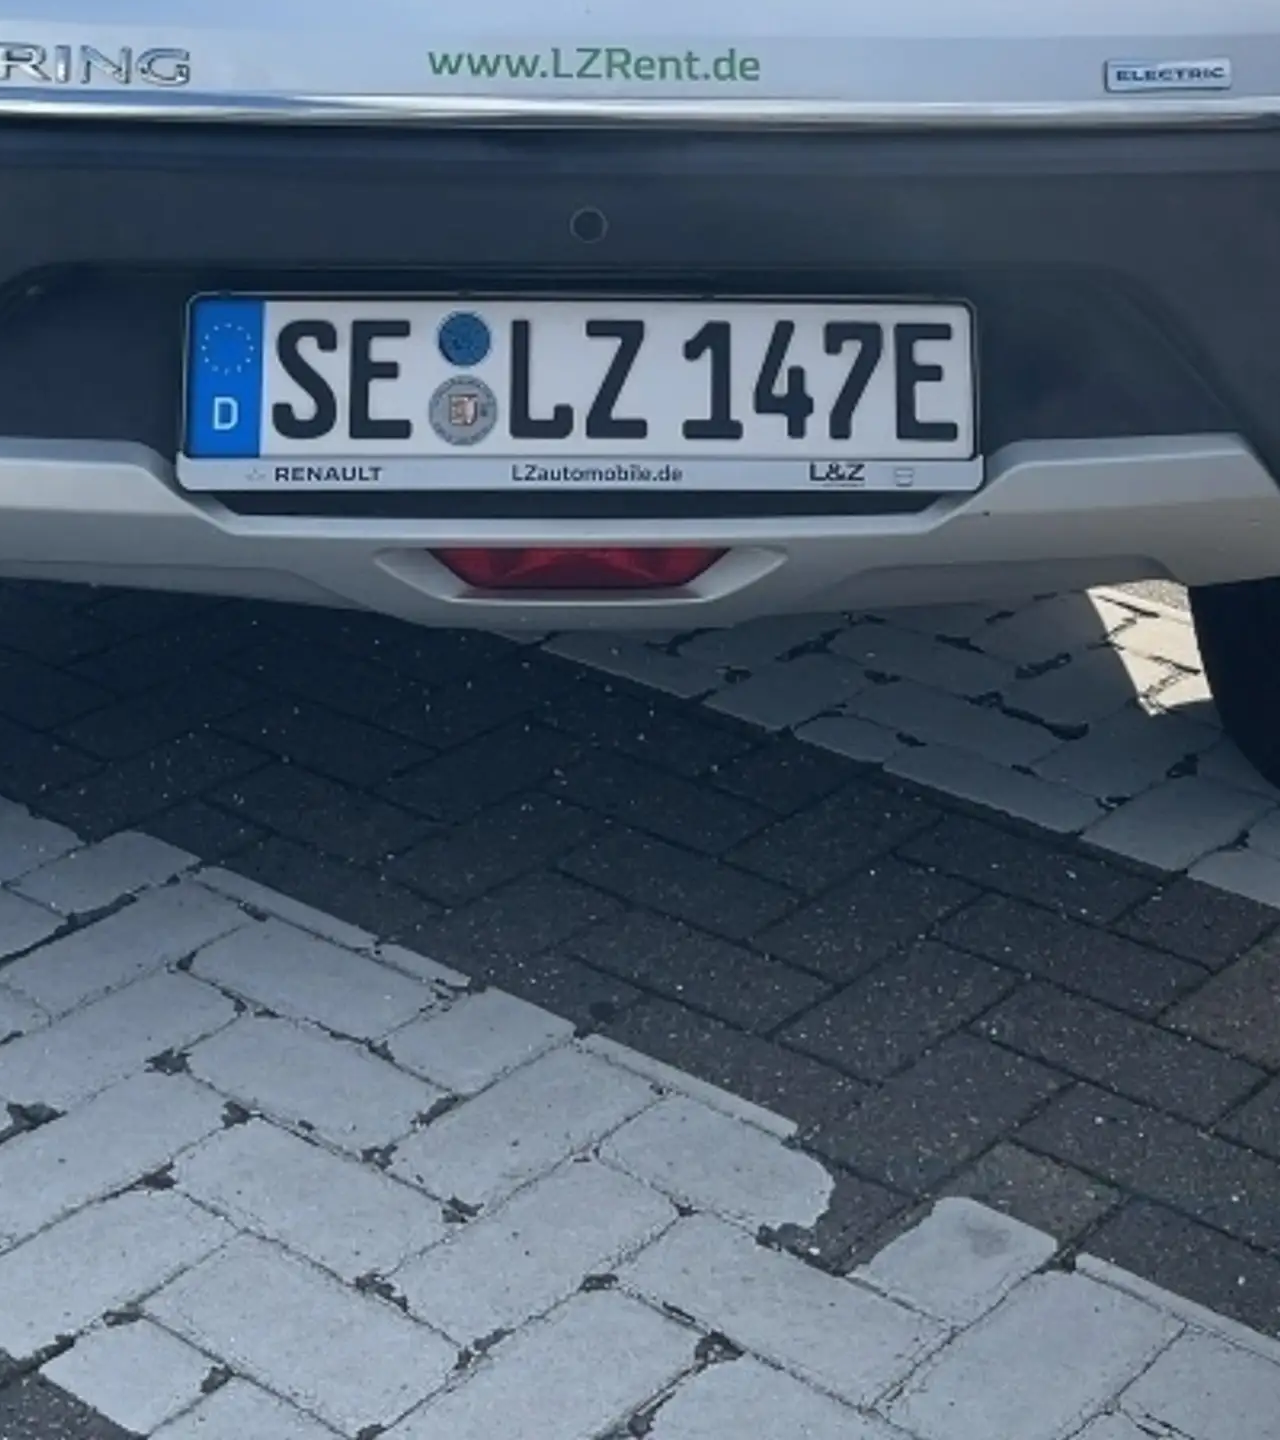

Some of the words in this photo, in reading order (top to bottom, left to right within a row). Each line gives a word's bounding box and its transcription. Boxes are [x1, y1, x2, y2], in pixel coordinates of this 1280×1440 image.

[428, 47, 761, 81] www.LZRent.de
[1116, 67, 1225, 81] ELECTRIC
[272, 319, 412, 439] SE
[510, 320, 647, 440] LZ
[682, 321, 957, 442] 147E
[212, 396, 239, 430] D
[274, 466, 382, 482] RENAULT
[511, 464, 683, 482] LZautomobile.de
[809, 463, 865, 482] L&Z
